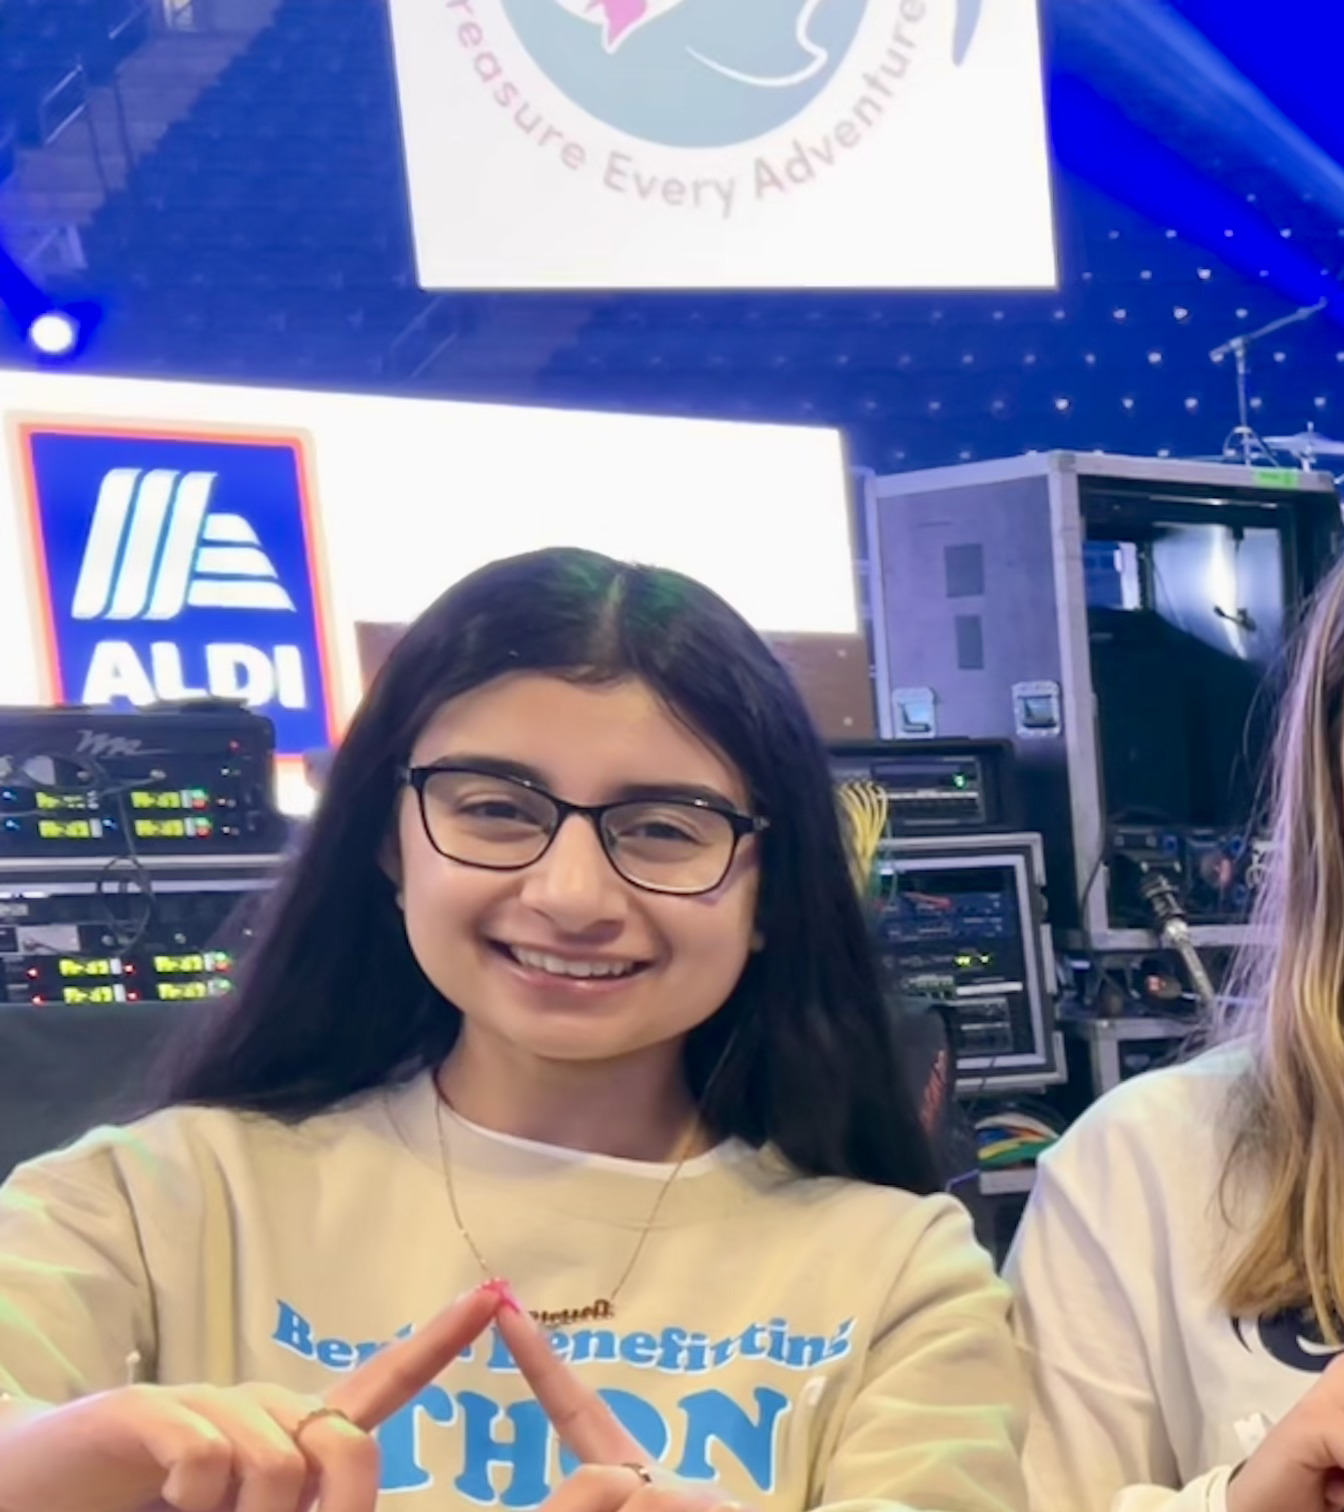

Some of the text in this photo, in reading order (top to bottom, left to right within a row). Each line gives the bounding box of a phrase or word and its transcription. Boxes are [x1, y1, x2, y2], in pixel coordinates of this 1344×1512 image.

[446, 0, 928, 220] reasure Every Adventure
[81, 640, 307, 709] ALDI
